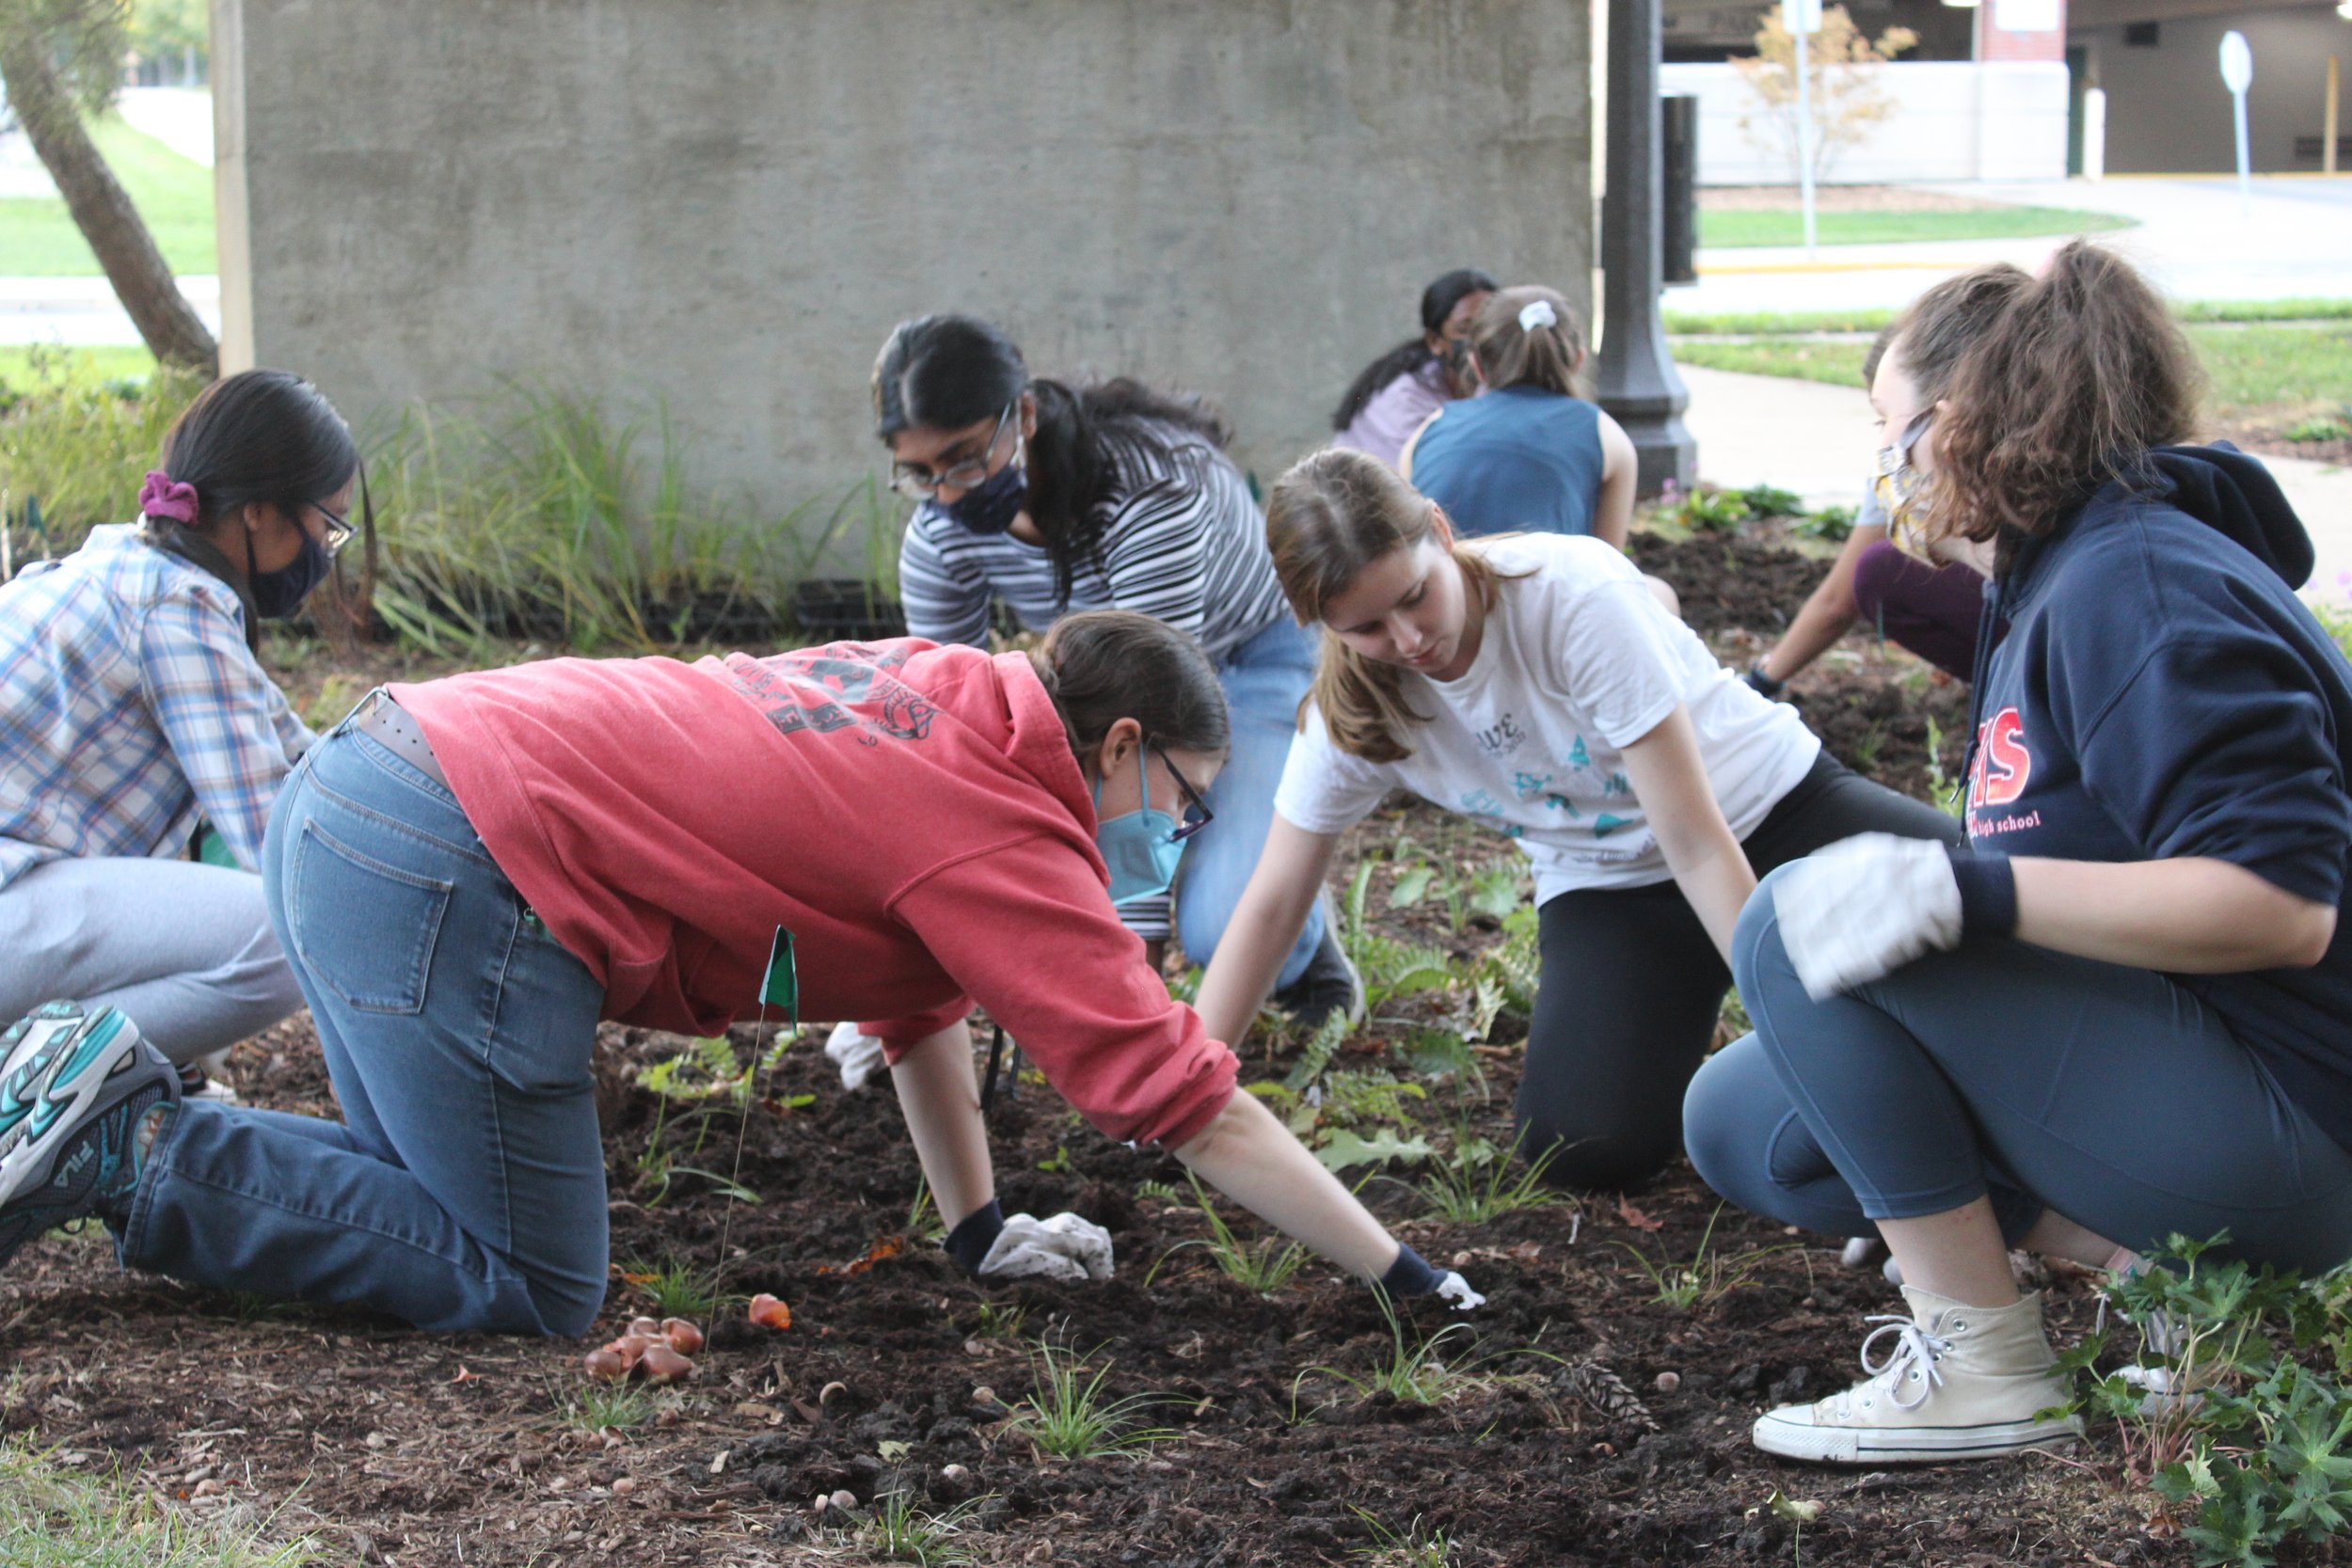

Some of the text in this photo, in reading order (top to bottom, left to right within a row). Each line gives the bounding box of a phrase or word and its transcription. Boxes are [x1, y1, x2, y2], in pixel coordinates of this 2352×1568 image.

[1979, 818, 1994, 837] high
[1997, 810, 2041, 833] school
[54, 1140, 94, 1187] FILA
